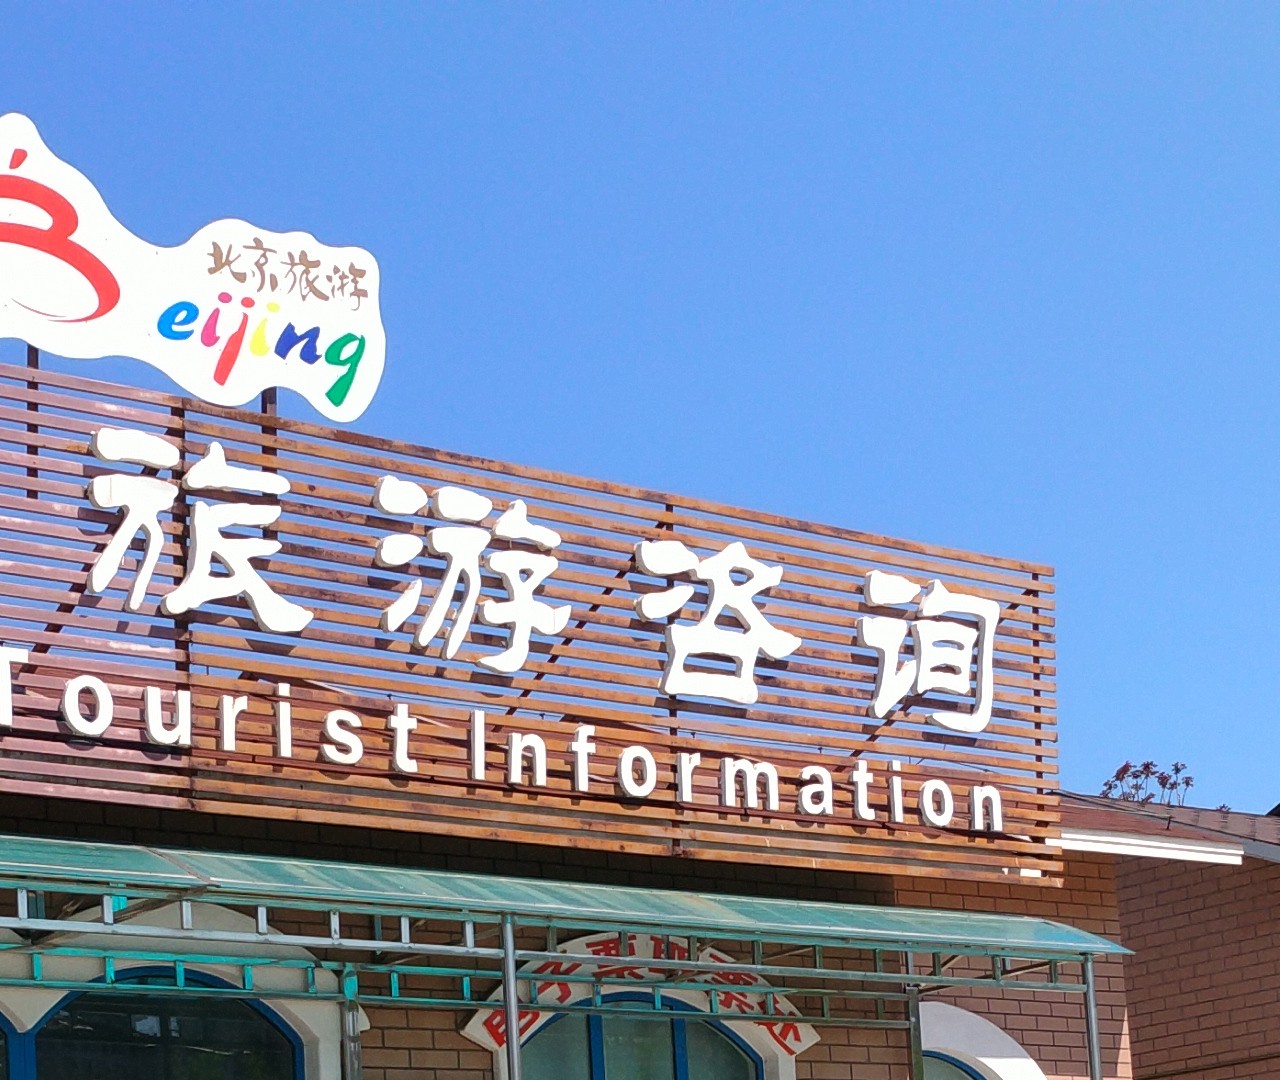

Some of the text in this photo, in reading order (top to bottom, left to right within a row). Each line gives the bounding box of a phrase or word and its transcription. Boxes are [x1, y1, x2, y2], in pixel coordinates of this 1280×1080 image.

[207, 237, 368, 311] 北京旅游
[469, 710, 1004, 834] Information
